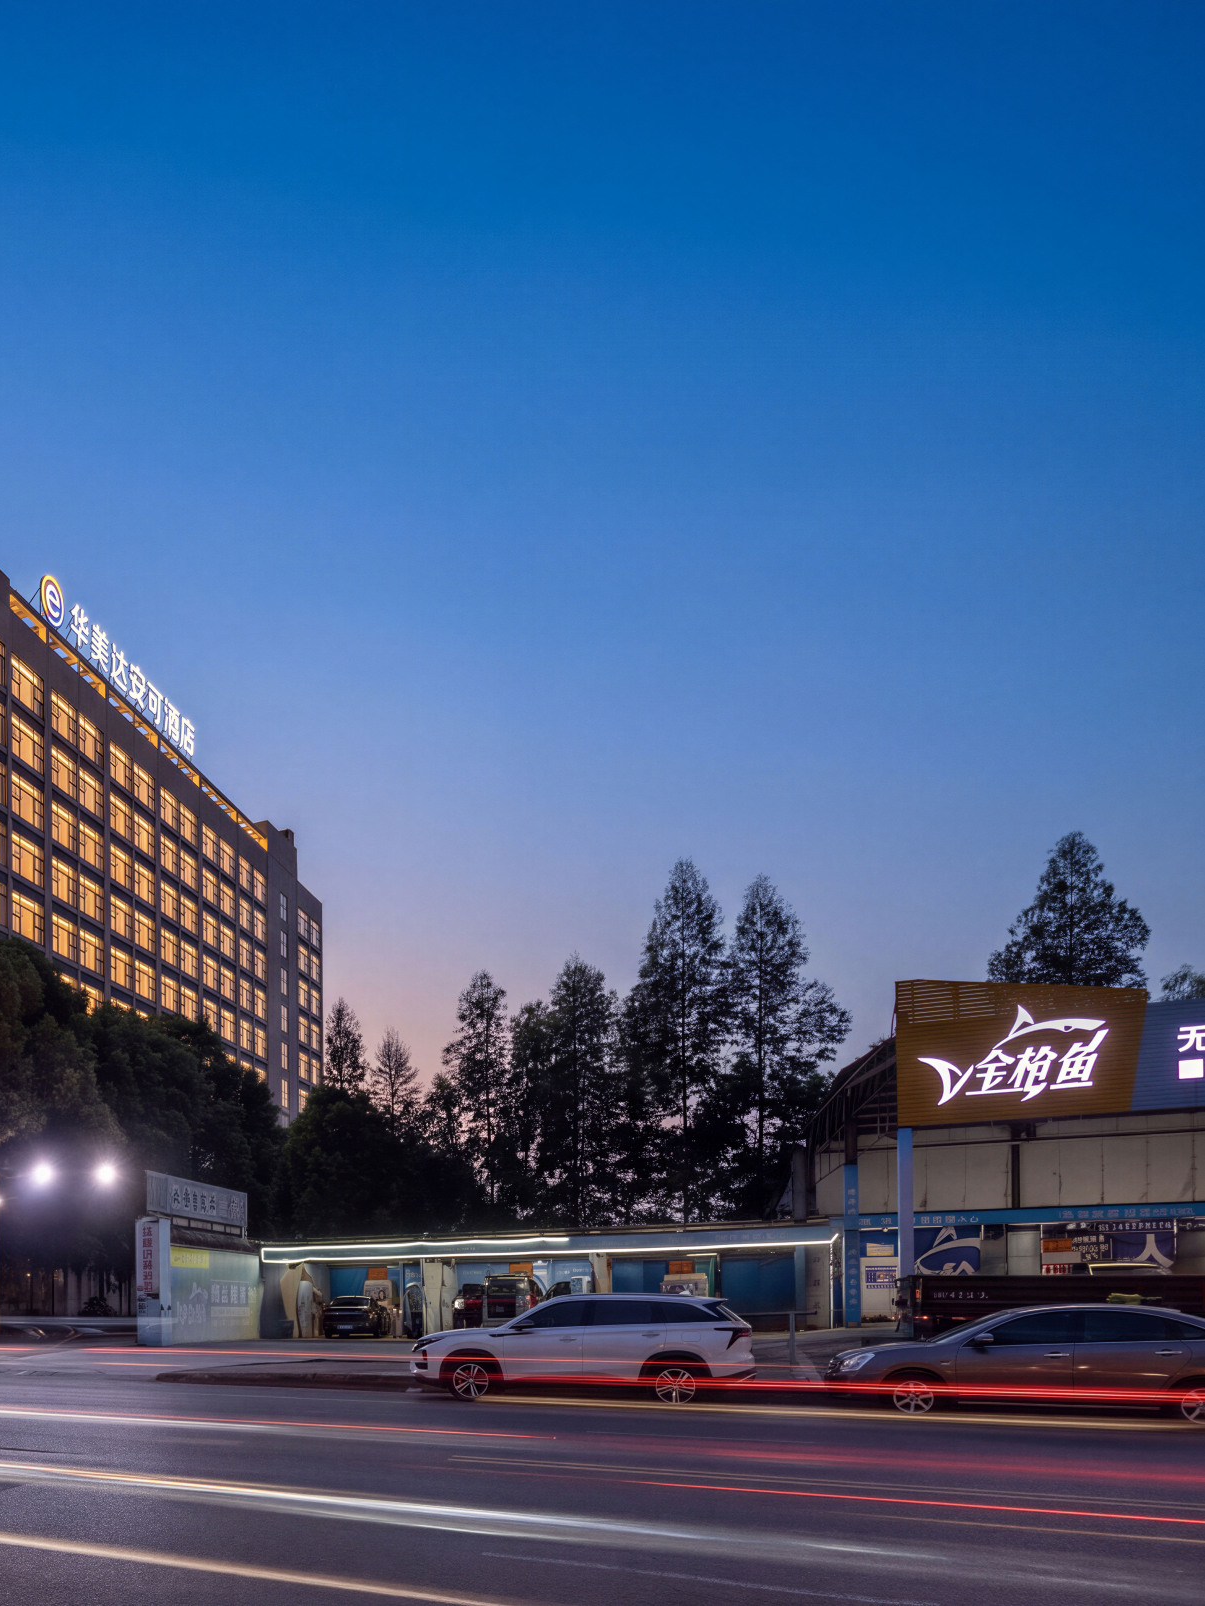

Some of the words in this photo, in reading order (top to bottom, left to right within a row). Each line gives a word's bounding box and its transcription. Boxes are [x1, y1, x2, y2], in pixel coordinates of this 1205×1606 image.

[71, 604, 195, 756] 华美达安可酒店
[964, 1028, 1110, 1102] 金枪鱼
